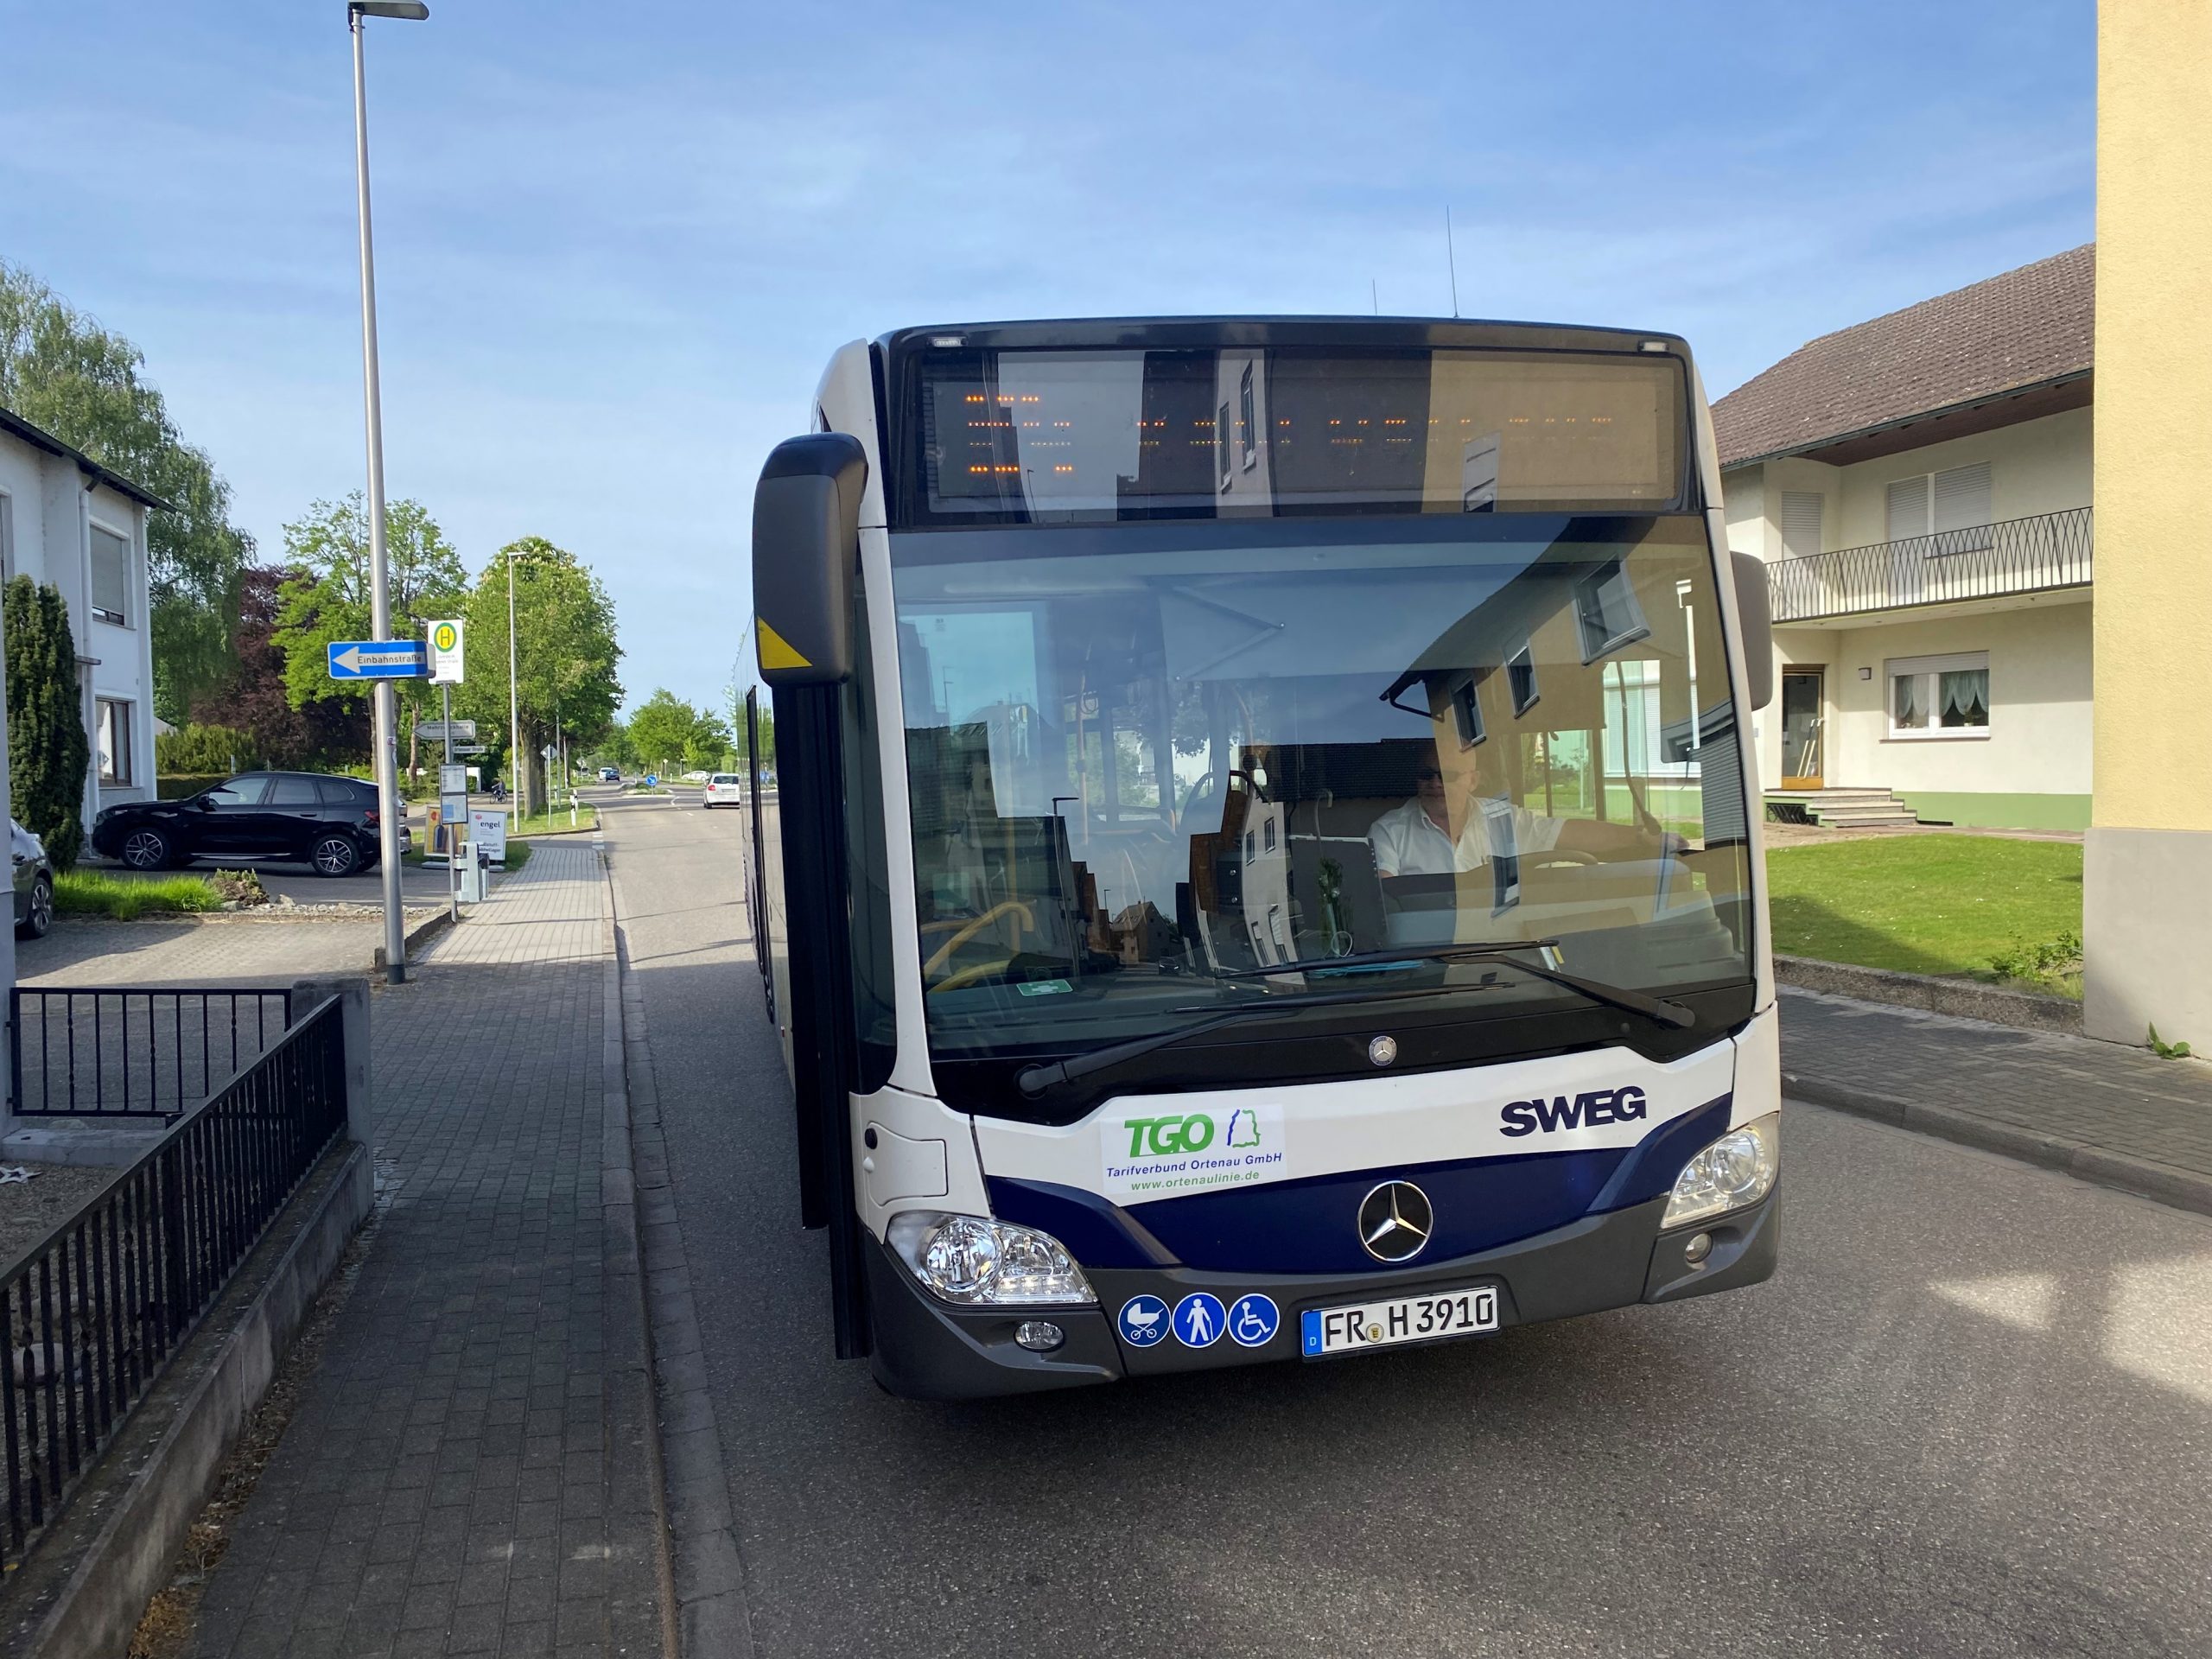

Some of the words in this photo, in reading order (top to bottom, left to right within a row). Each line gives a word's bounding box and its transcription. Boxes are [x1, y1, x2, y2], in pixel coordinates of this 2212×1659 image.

[357, 654, 422, 664] Einbahnstraße
[480, 821, 500, 830] engel
[1499, 1085, 1647, 1137] SWEG
[1124, 1114, 1215, 1158] TGO
[1107, 1161, 1186, 1178] Tarifverbund
[1191, 1157, 1241, 1170] Ortenau
[1245, 1152, 1282, 1165] GmbH
[1131, 1170, 1260, 1191] www.ortenaulinie.de
[1325, 1310, 1366, 1347] FR
